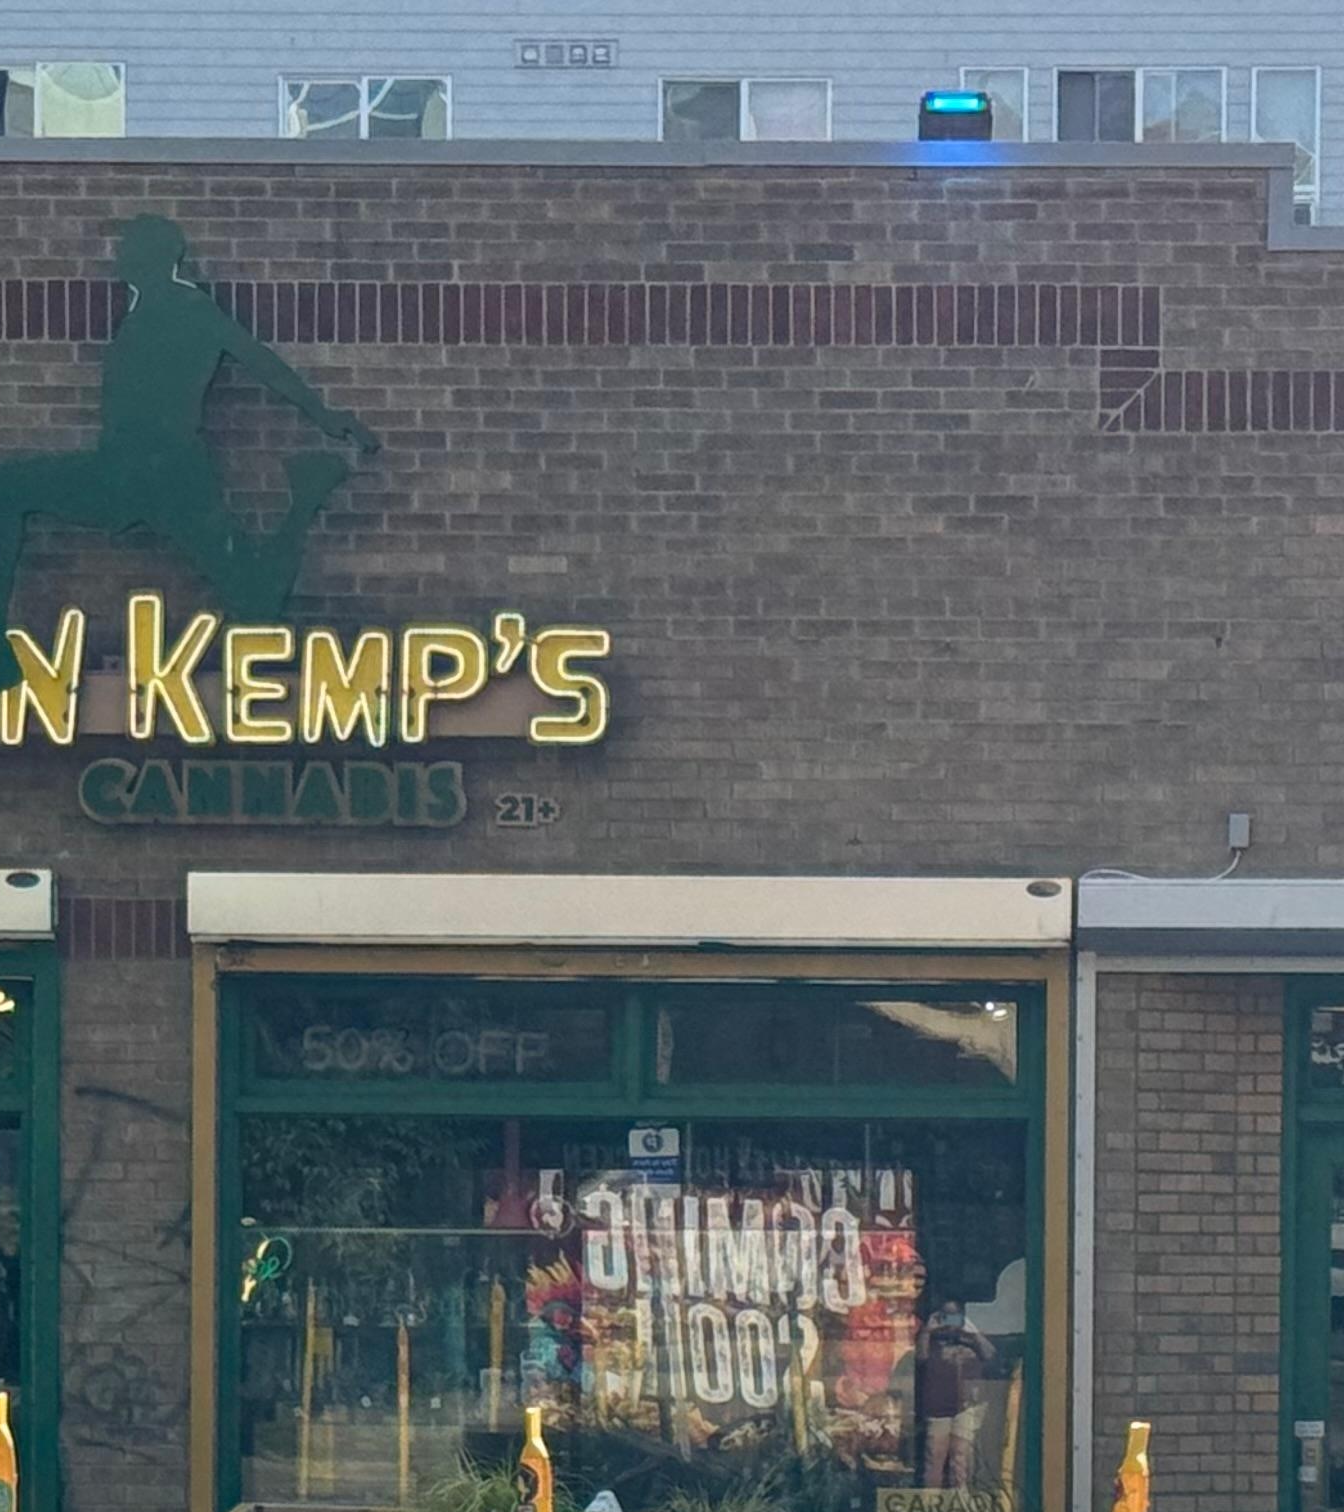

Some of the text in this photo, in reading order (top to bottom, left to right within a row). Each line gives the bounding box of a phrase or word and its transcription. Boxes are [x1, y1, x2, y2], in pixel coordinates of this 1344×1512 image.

[128, 594, 612, 747] KEMP'S
[496, 793, 561, 827] 21+
[301, 1023, 551, 1076] 50% OFF
